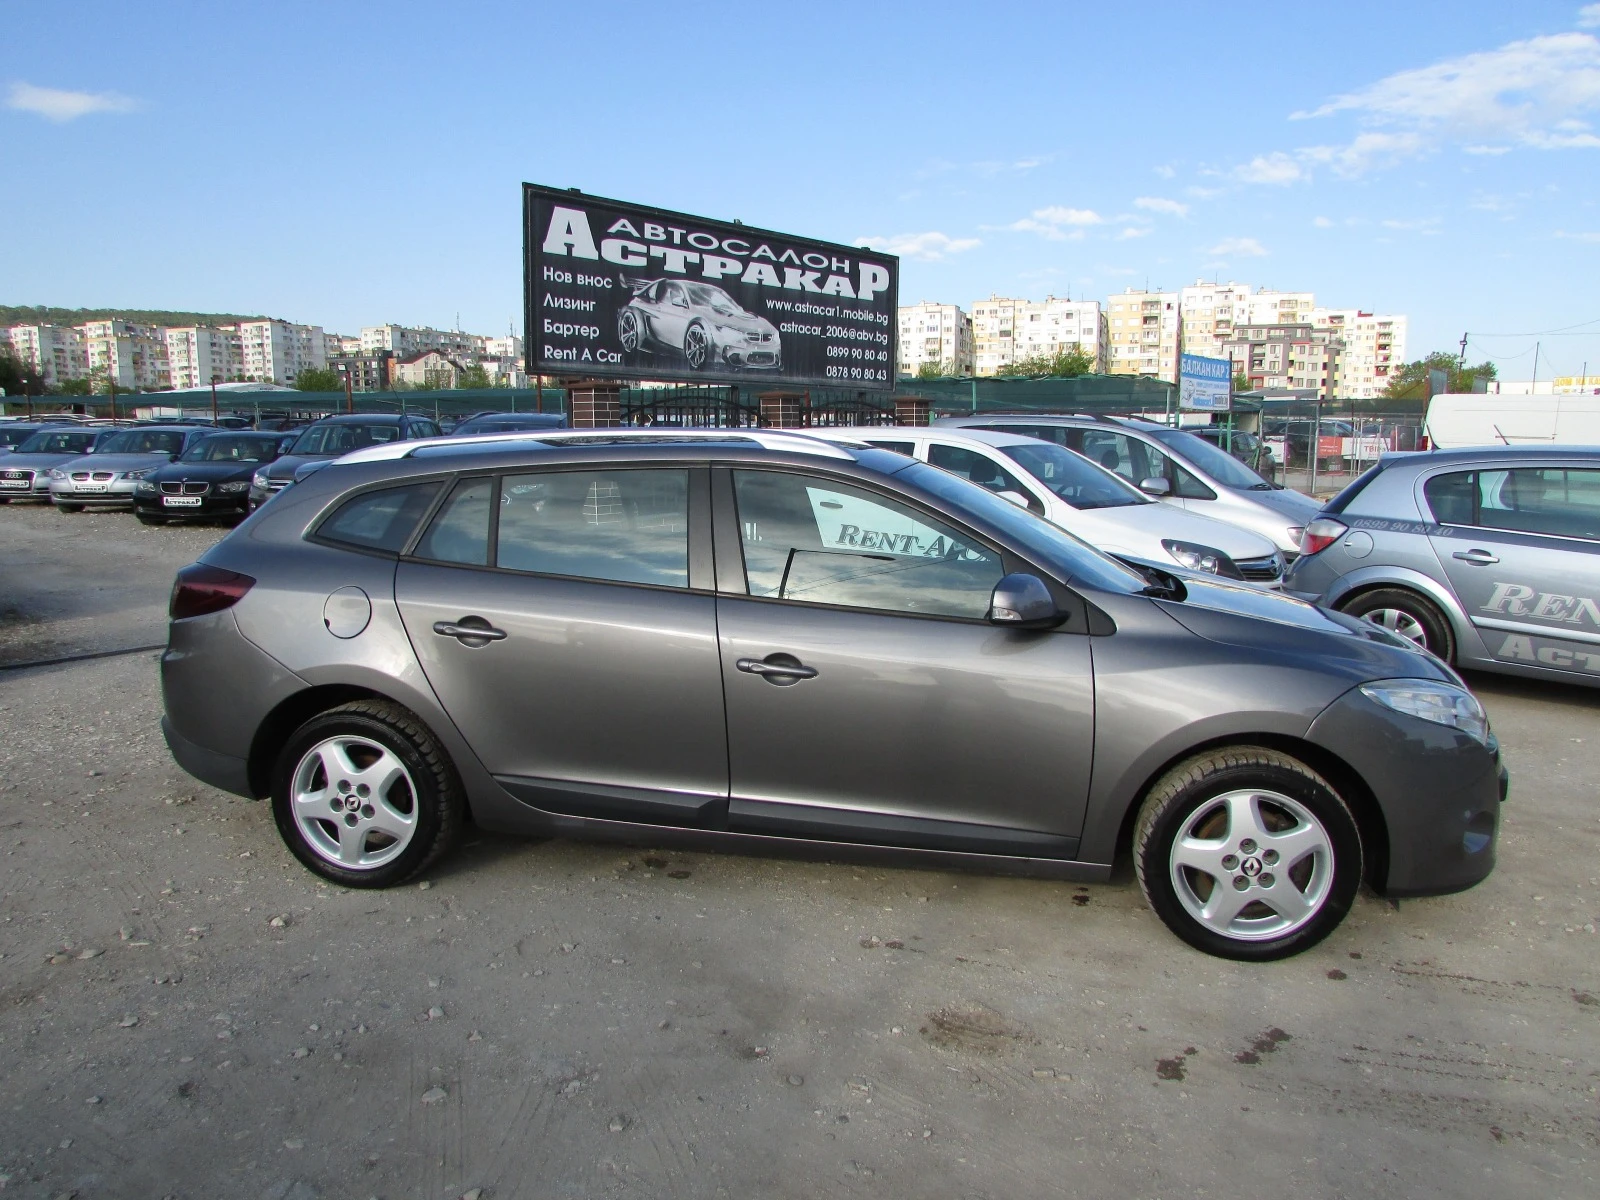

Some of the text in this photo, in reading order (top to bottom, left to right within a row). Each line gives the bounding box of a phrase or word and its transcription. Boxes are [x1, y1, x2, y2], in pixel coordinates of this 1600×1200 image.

[607, 218, 850, 274] АВТОСАЛОН
[543, 266, 613, 289] Нов внос
[543, 293, 596, 311] Лизинг
[766, 299, 888, 326] www.astracar1.mobile.bg
[544, 318, 600, 340] Бартер
[780, 321, 888, 345] astracar_2006@abv.bg
[544, 344, 623, 362] Rent A Car
[826, 345, 888, 361] 0899 90 80 40
[826, 365, 887, 380] 0878 90 80 43
[1181, 359, 1211, 377] БАЛКАН
[1211, 363, 1225, 378] КАР
[1353, 519, 1454, 536] 0899 90 80 40
